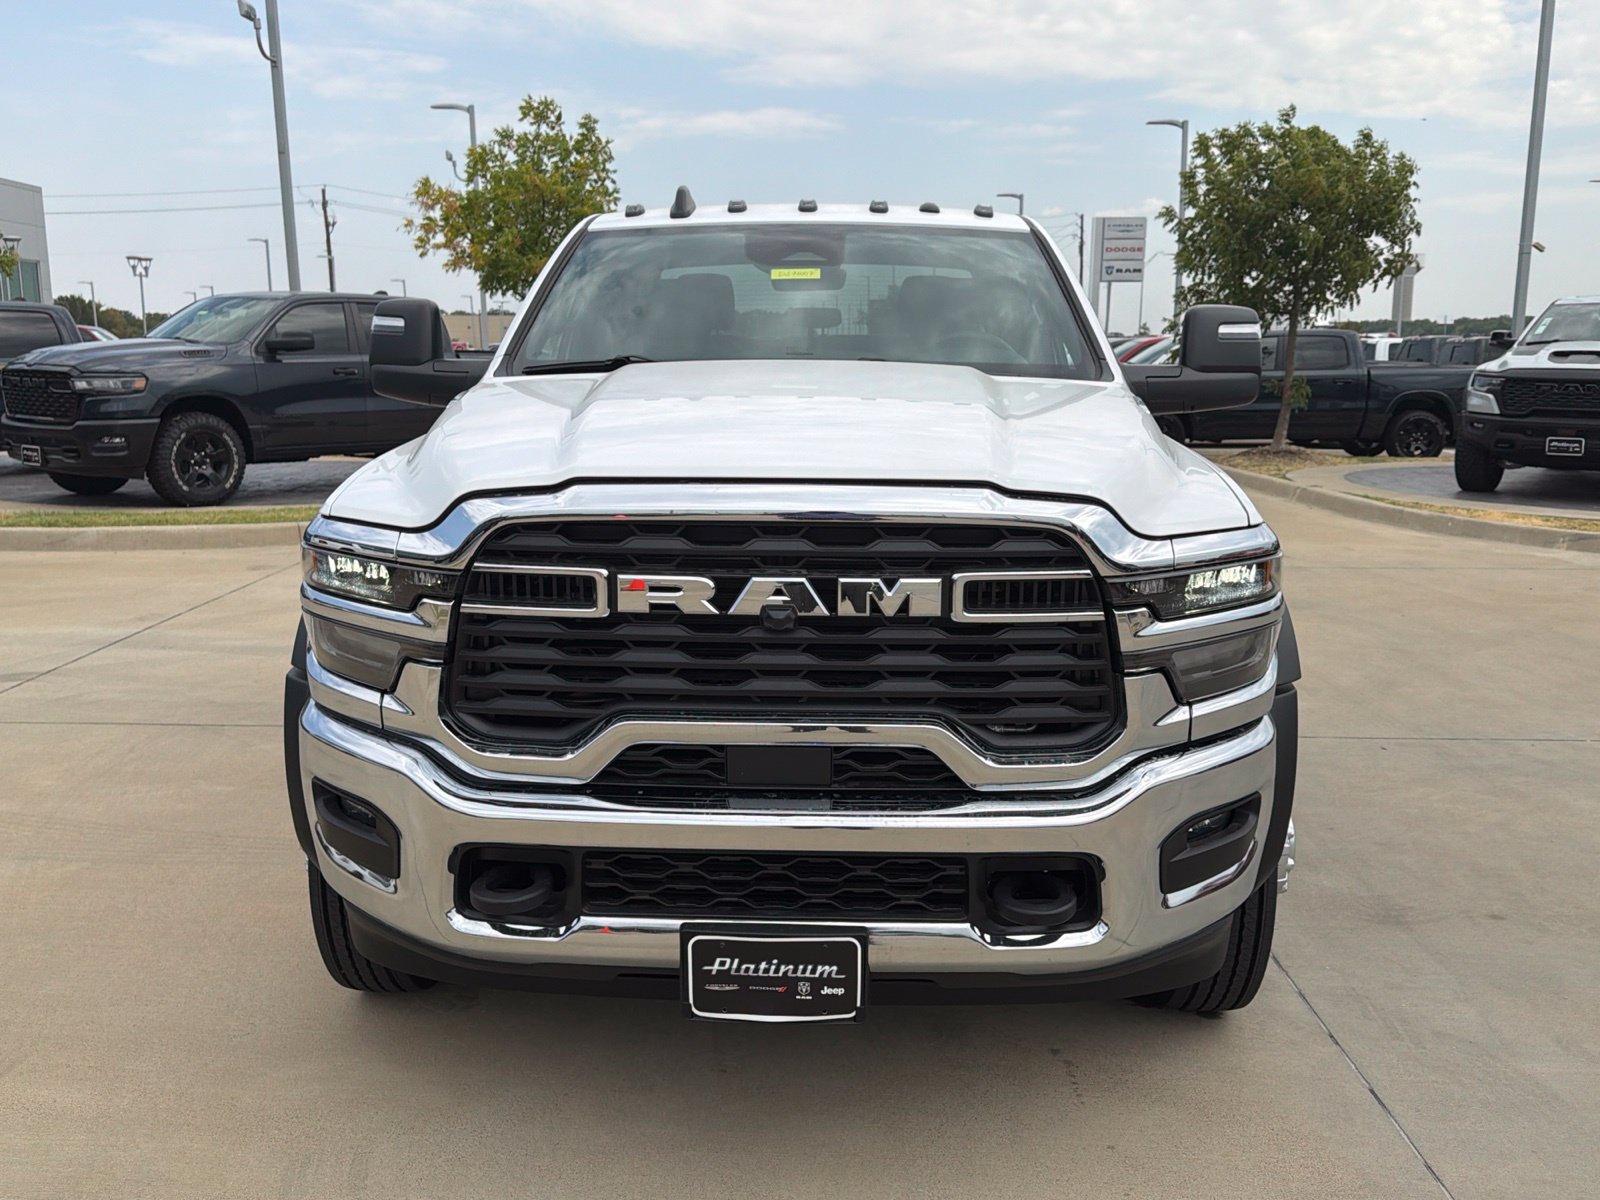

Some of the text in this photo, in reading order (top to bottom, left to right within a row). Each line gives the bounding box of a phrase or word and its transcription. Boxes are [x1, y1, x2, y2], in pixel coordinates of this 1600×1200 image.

[616, 574, 943, 617] RAM
[701, 957, 847, 979] Platinum
[820, 985, 845, 996] Jeep
